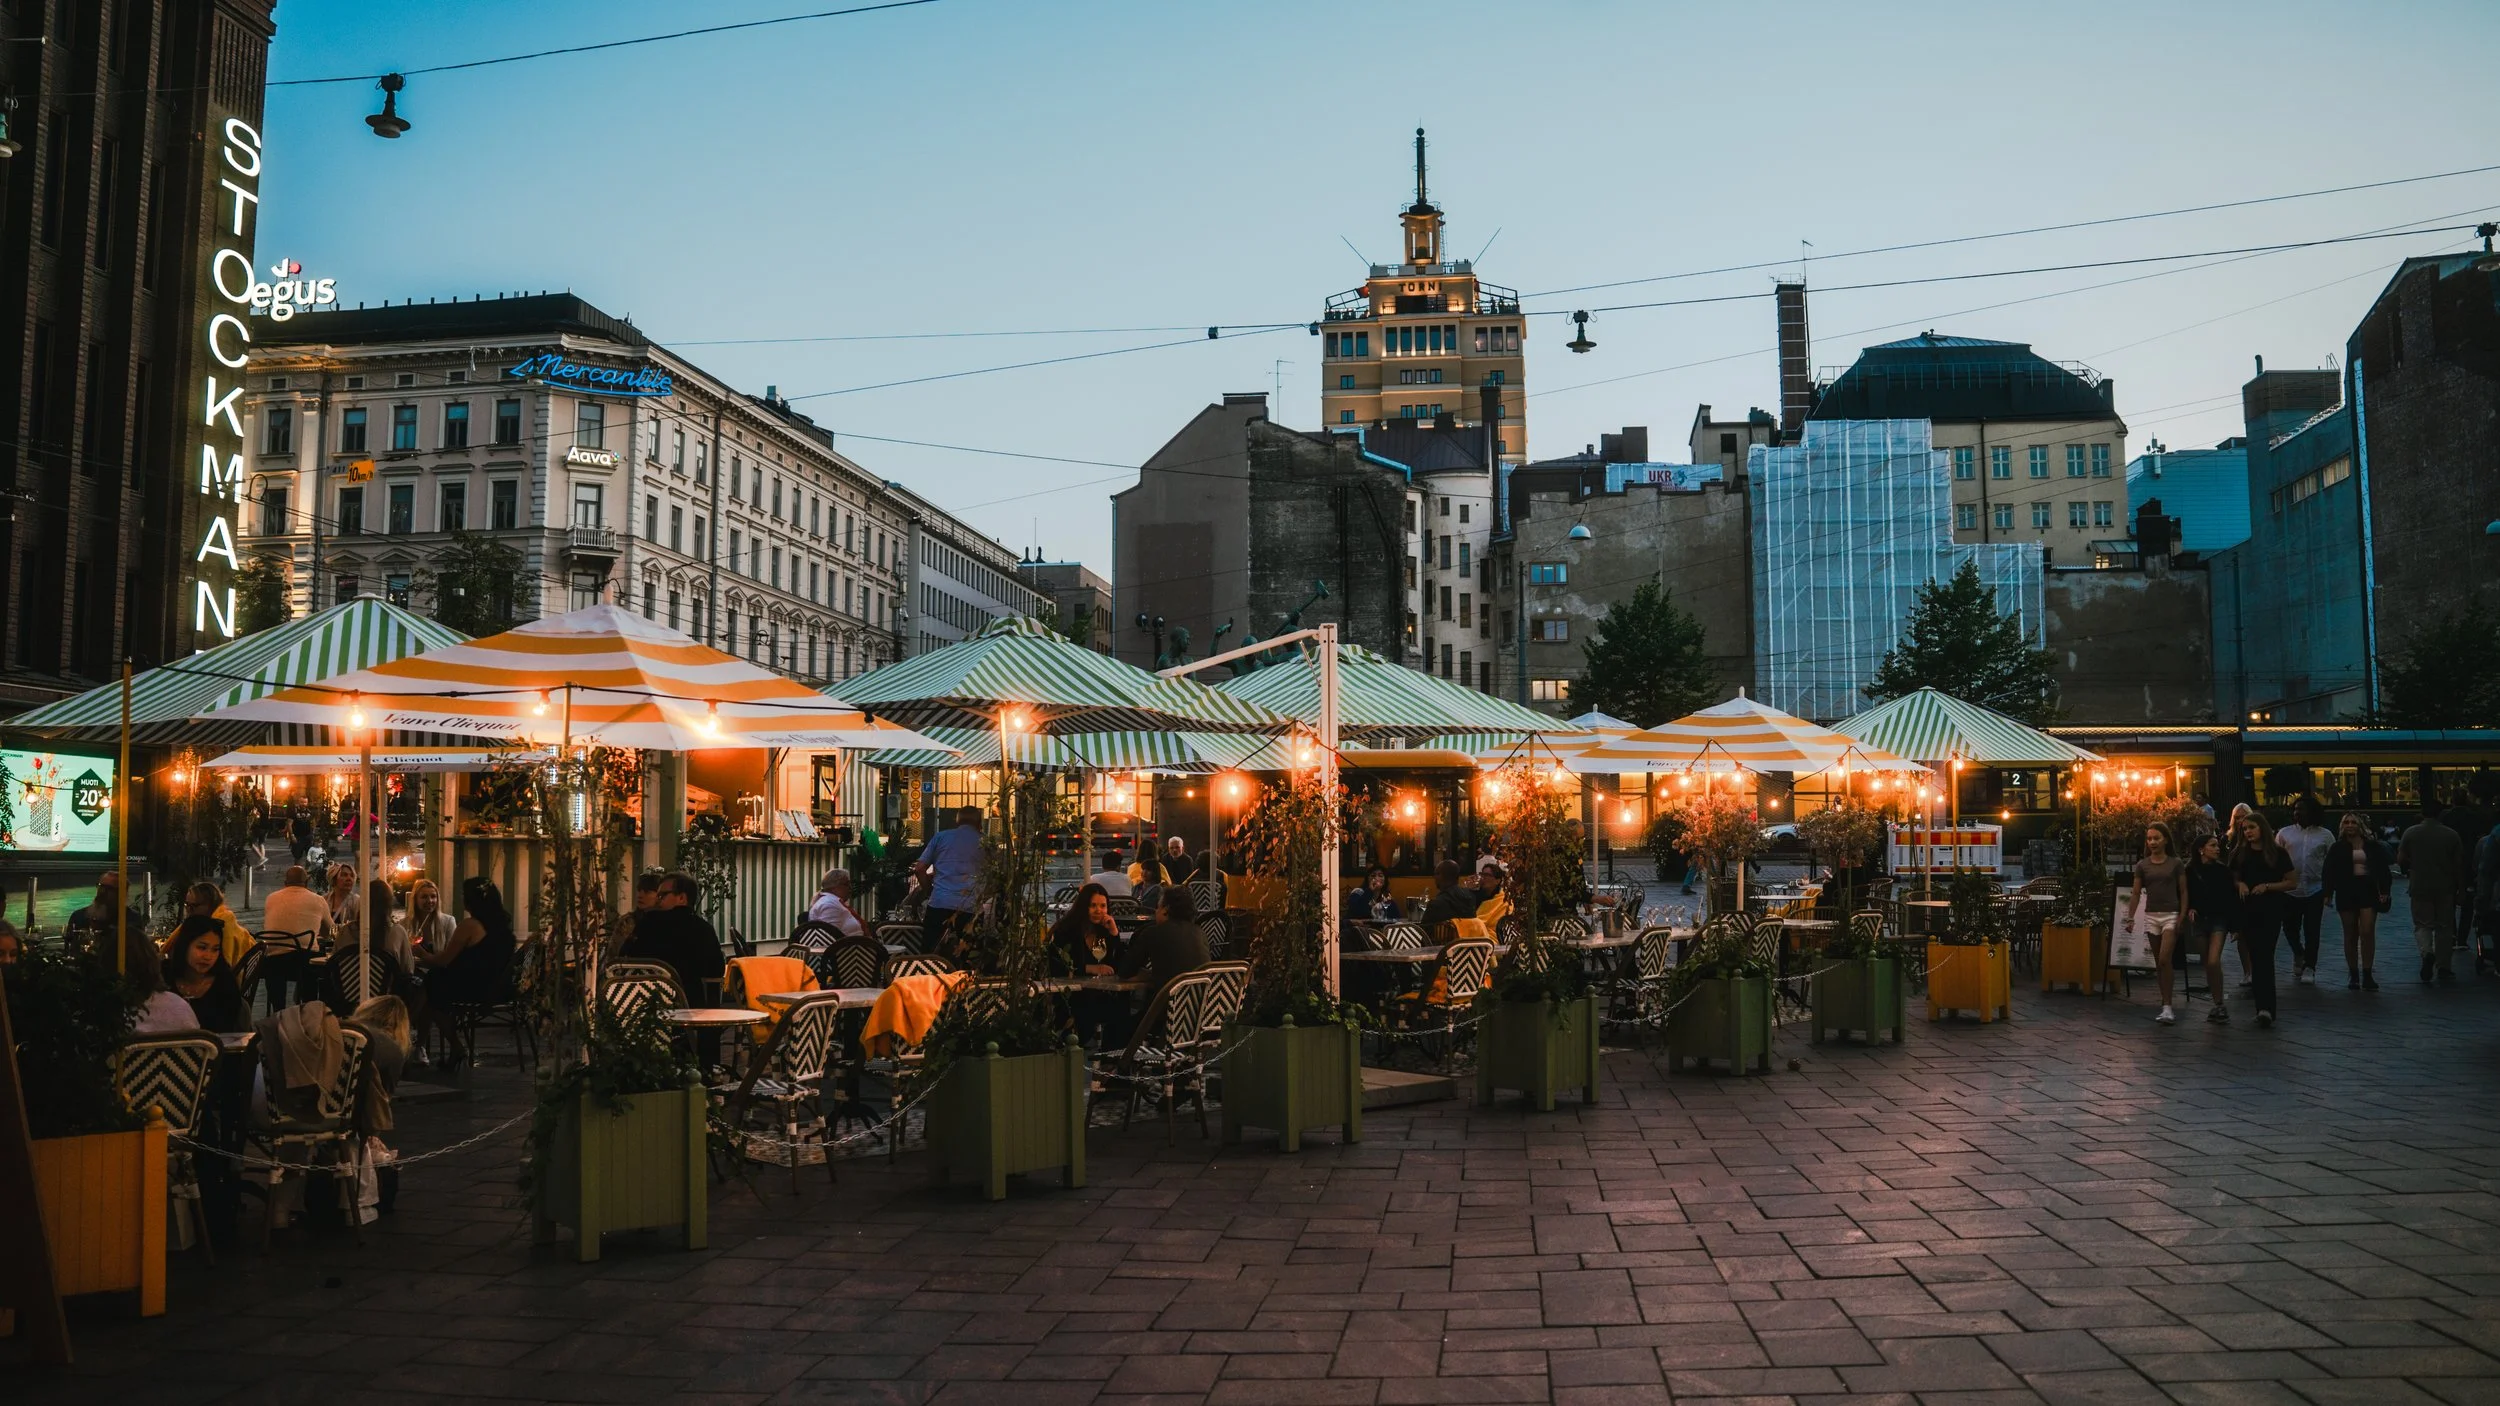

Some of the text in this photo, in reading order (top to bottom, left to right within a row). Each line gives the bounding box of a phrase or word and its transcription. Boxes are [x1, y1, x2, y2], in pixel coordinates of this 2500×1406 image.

[1398, 281, 1442, 292] TORNI
[250, 277, 337, 322] egus
[537, 353, 673, 391] Mercantile
[194, 117, 262, 655] STOCKMAN
[567, 446, 612, 465] Aava
[348, 465, 359, 482] 10
[1648, 470, 1672, 482] UKR
[438, 716, 523, 732] Clicquot
[383, 755, 443, 764] Clicquot
[80, 778, 98, 786] MUOTI
[2012, 773, 2021, 786] 2
